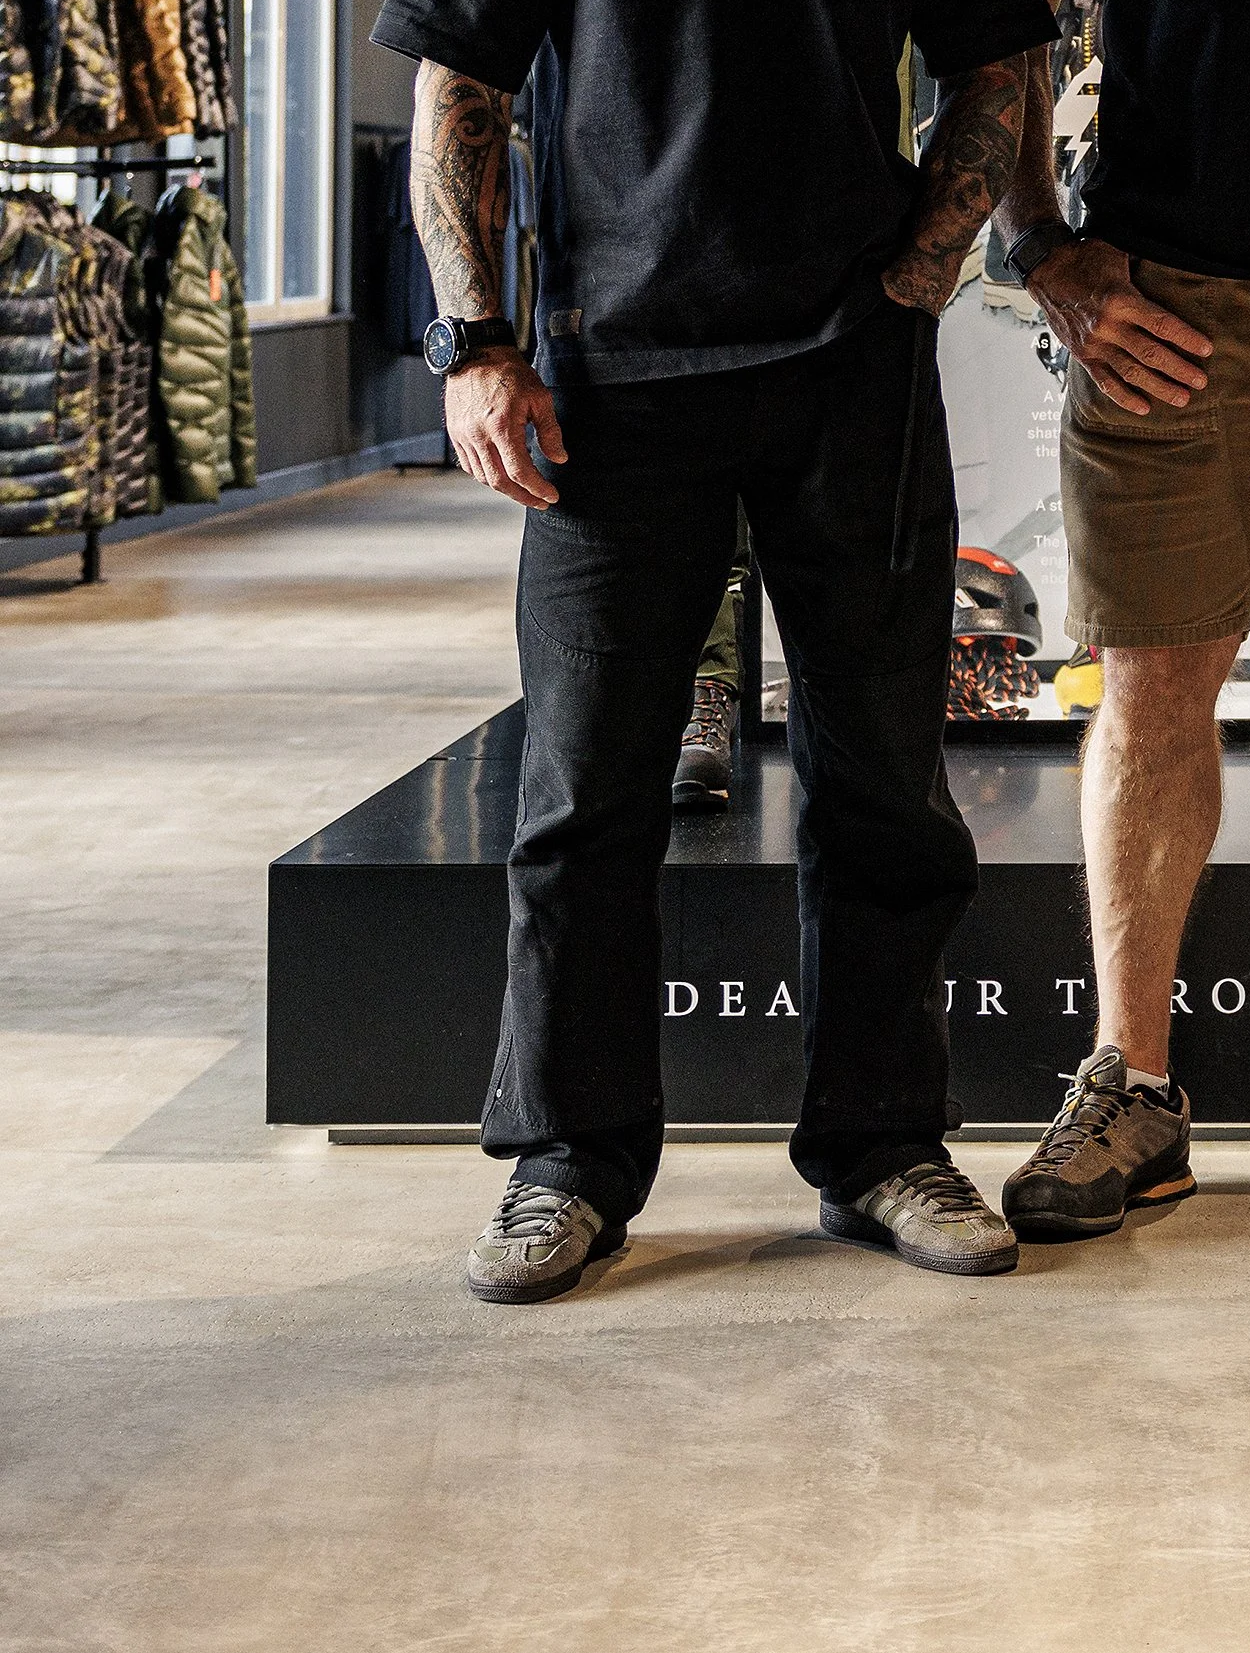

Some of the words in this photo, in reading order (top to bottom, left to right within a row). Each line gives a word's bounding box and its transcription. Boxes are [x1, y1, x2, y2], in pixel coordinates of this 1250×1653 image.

[1030, 336, 1049, 349] As
[1043, 390, 1054, 403] A
[1031, 409, 1061, 421] vete
[1027, 426, 1059, 440] shat
[1035, 499, 1047, 512] A
[1033, 535, 1060, 549] The
[1040, 554, 1067, 566] eng
[1040, 571, 1067, 584] abo
